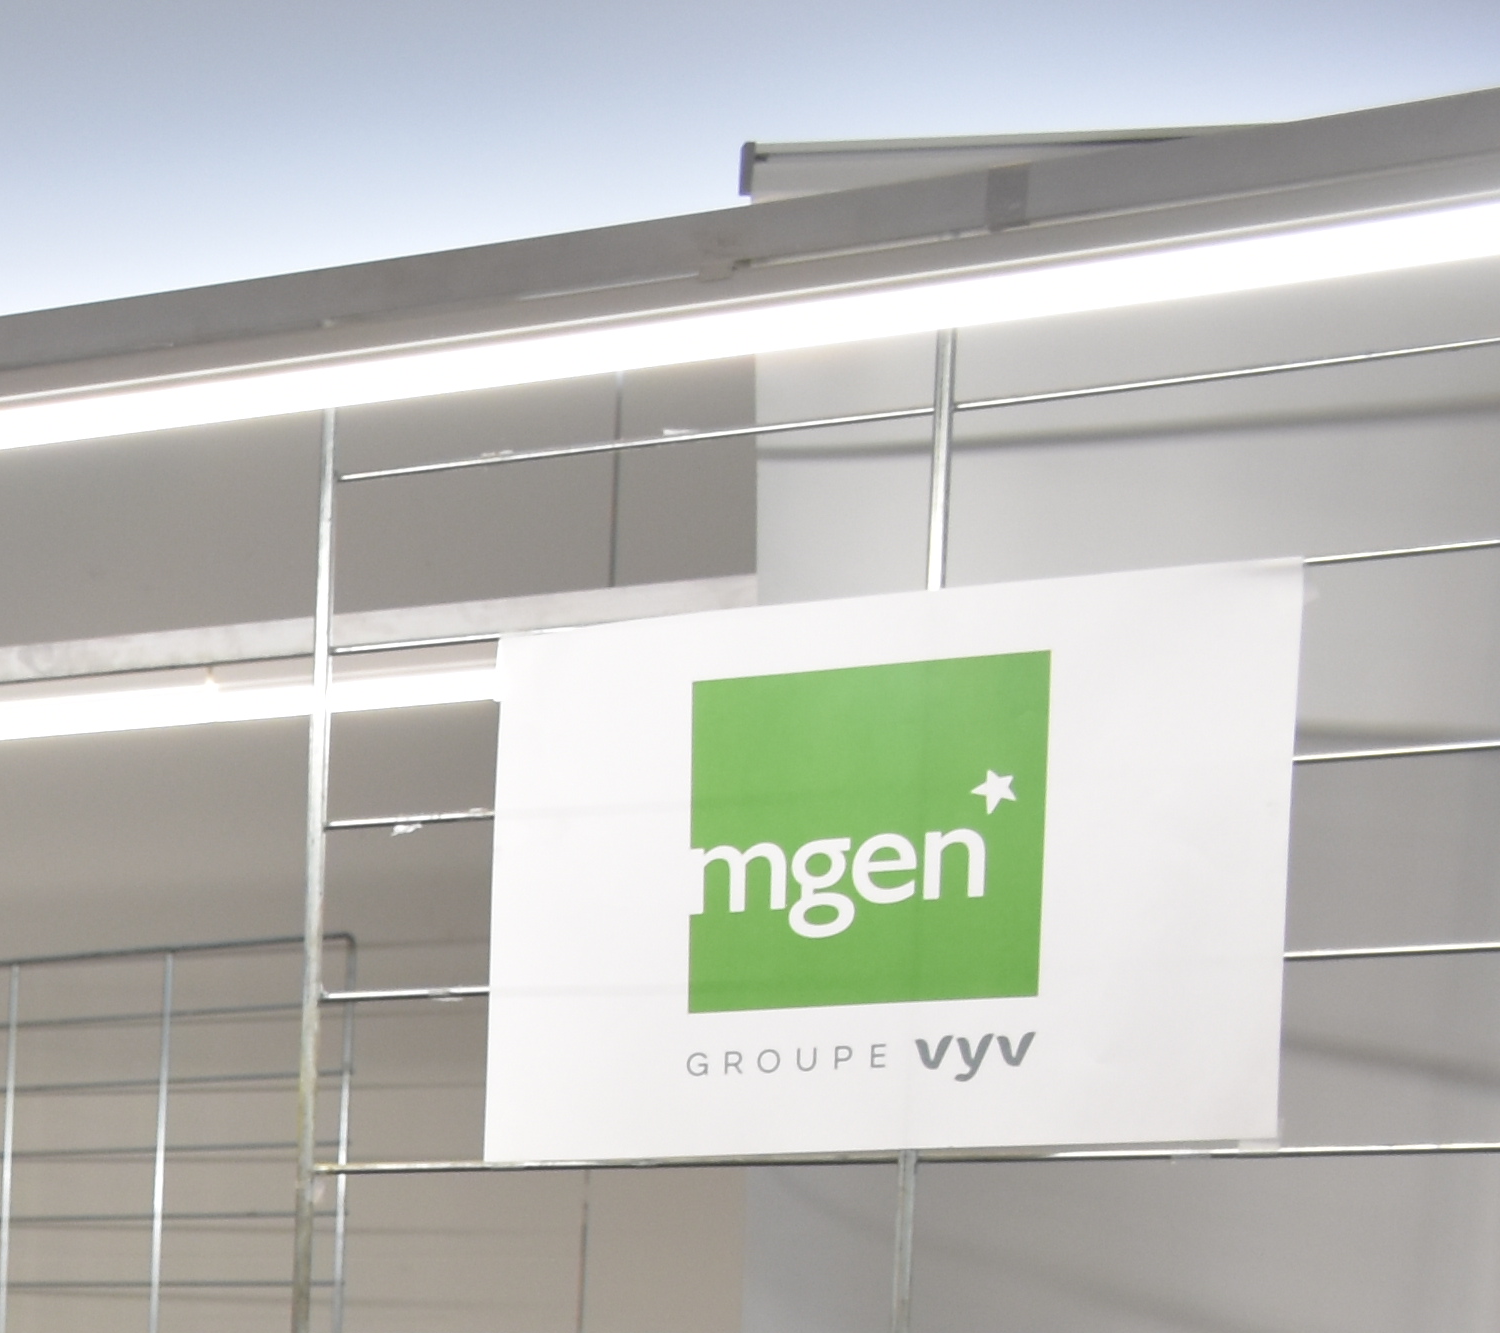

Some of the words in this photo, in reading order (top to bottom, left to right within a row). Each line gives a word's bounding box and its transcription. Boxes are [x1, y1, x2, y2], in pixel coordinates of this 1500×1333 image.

[688, 826, 986, 939] mgen
[686, 1041, 889, 1079] GROUPE
[915, 1031, 1037, 1083] vyv
